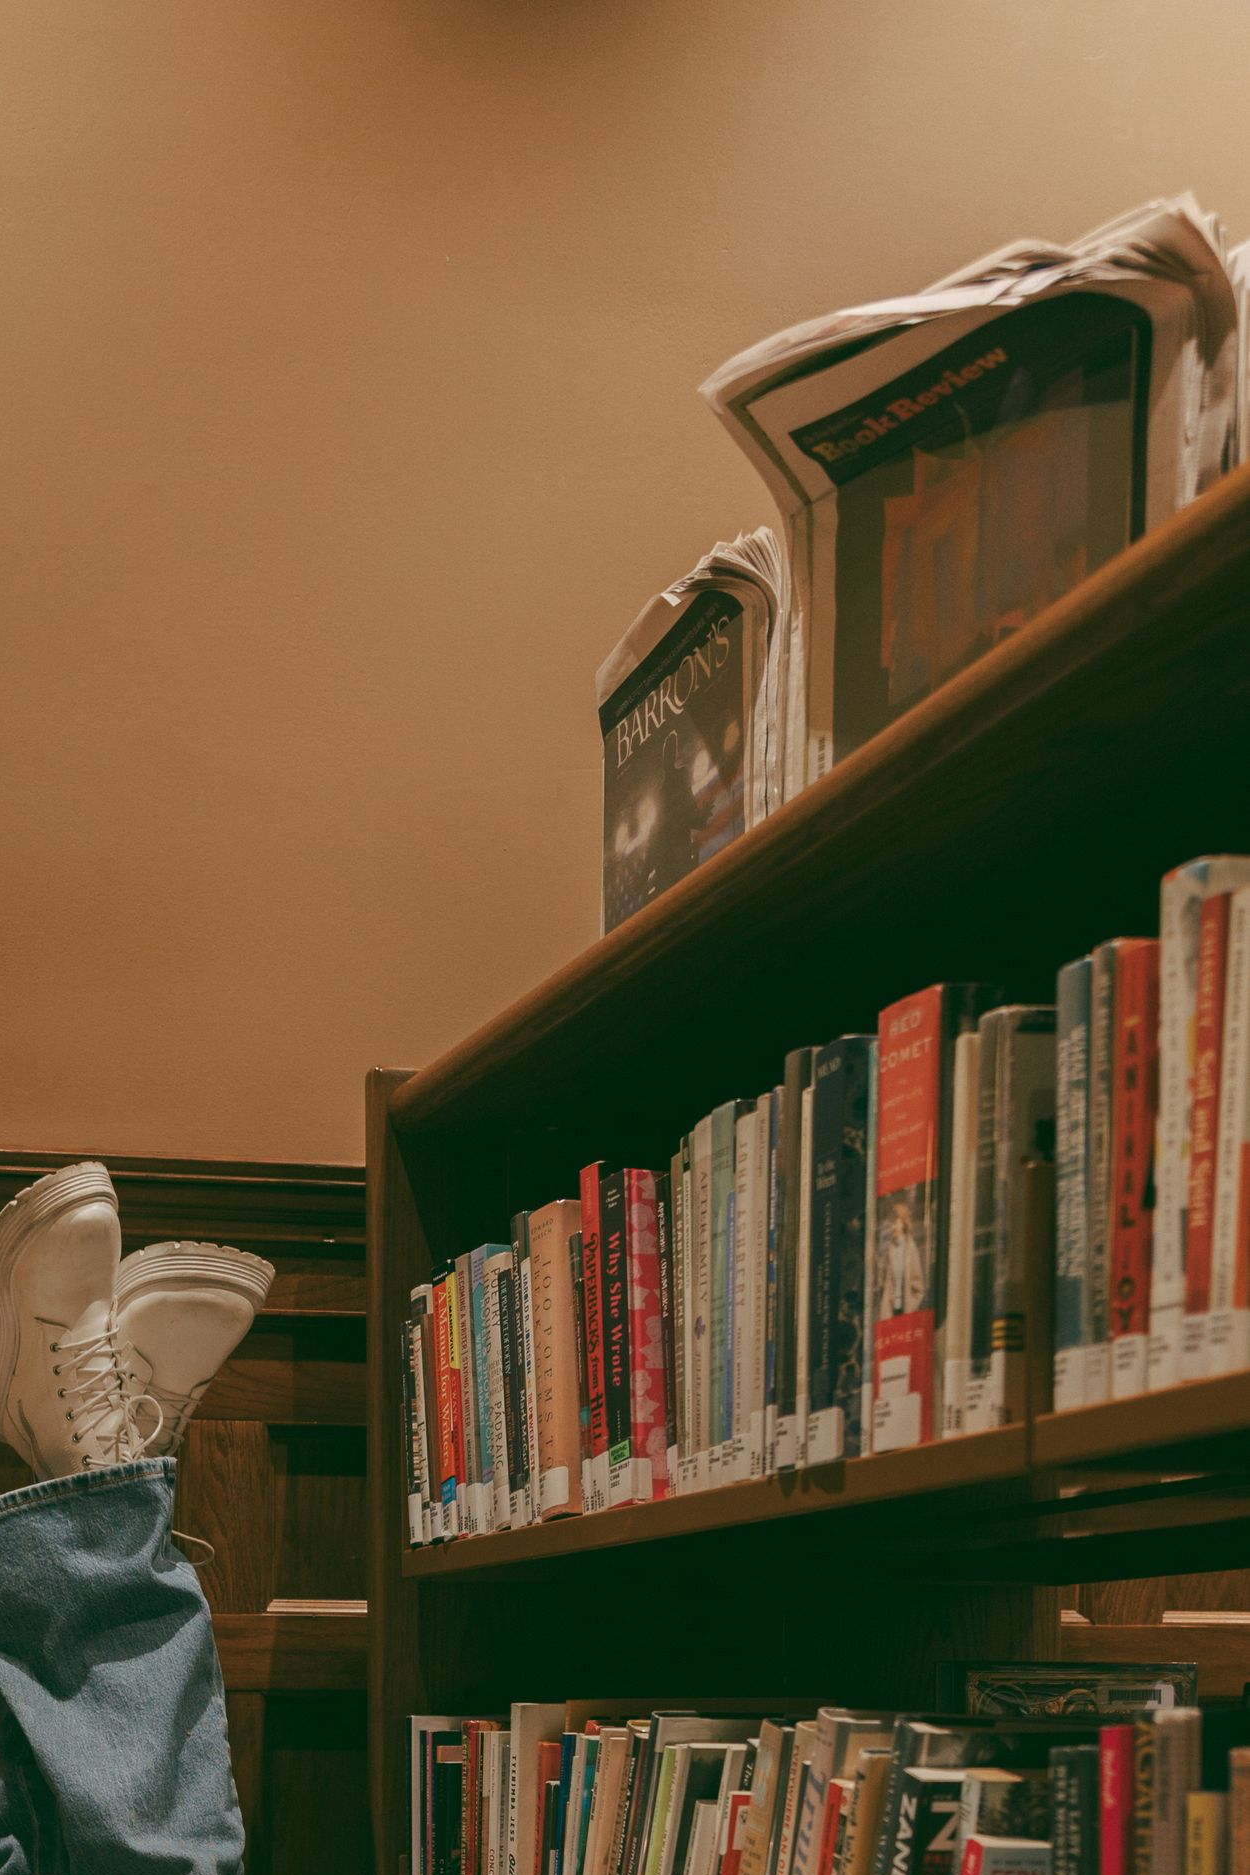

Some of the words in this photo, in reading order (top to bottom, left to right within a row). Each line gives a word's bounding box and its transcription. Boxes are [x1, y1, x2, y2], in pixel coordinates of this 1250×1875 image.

[812, 416, 897, 463] Book
[888, 347, 1008, 422] Review
[617, 616, 731, 769] BARRON'S
[889, 1009, 922, 1039] RED
[880, 1035, 934, 1073] COMET
[1194, 1050, 1216, 1099] Soil
[1193, 1108, 1216, 1153] and
[699, 1172, 708, 1232] AFTER
[1188, 1159, 1213, 1228] Spirit
[512, 1240, 522, 1301] Everything
[606, 1232, 621, 1277] Why
[699, 1240, 708, 1302] EMILY
[736, 1210, 747, 1308] ASHBERY
[438, 1290, 447, 1303] A
[458, 1271, 467, 1312] BECOMING
[582, 1233, 602, 1354] PAPERBACKS
[609, 1283, 624, 1318] She
[438, 1308, 450, 1367] Manual
[460, 1321, 469, 1350] WRITER
[514, 1308, 523, 1332] and
[524, 1326, 533, 1375] JOHNSON
[542, 1326, 554, 1422] POEMS
[589, 1356, 602, 1389] from
[610, 1324, 623, 1387] Wrote
[440, 1374, 452, 1394] for
[518, 1389, 527, 1420] Mark
[440, 1405, 453, 1467] Writers
[462, 1398, 472, 1428] WRITER
[590, 1392, 606, 1443] HELL
[782, 1745, 801, 1830] EVERYWHERE
[780, 1835, 789, 1855] AN
[1068, 1809, 1082, 1857] LADY
